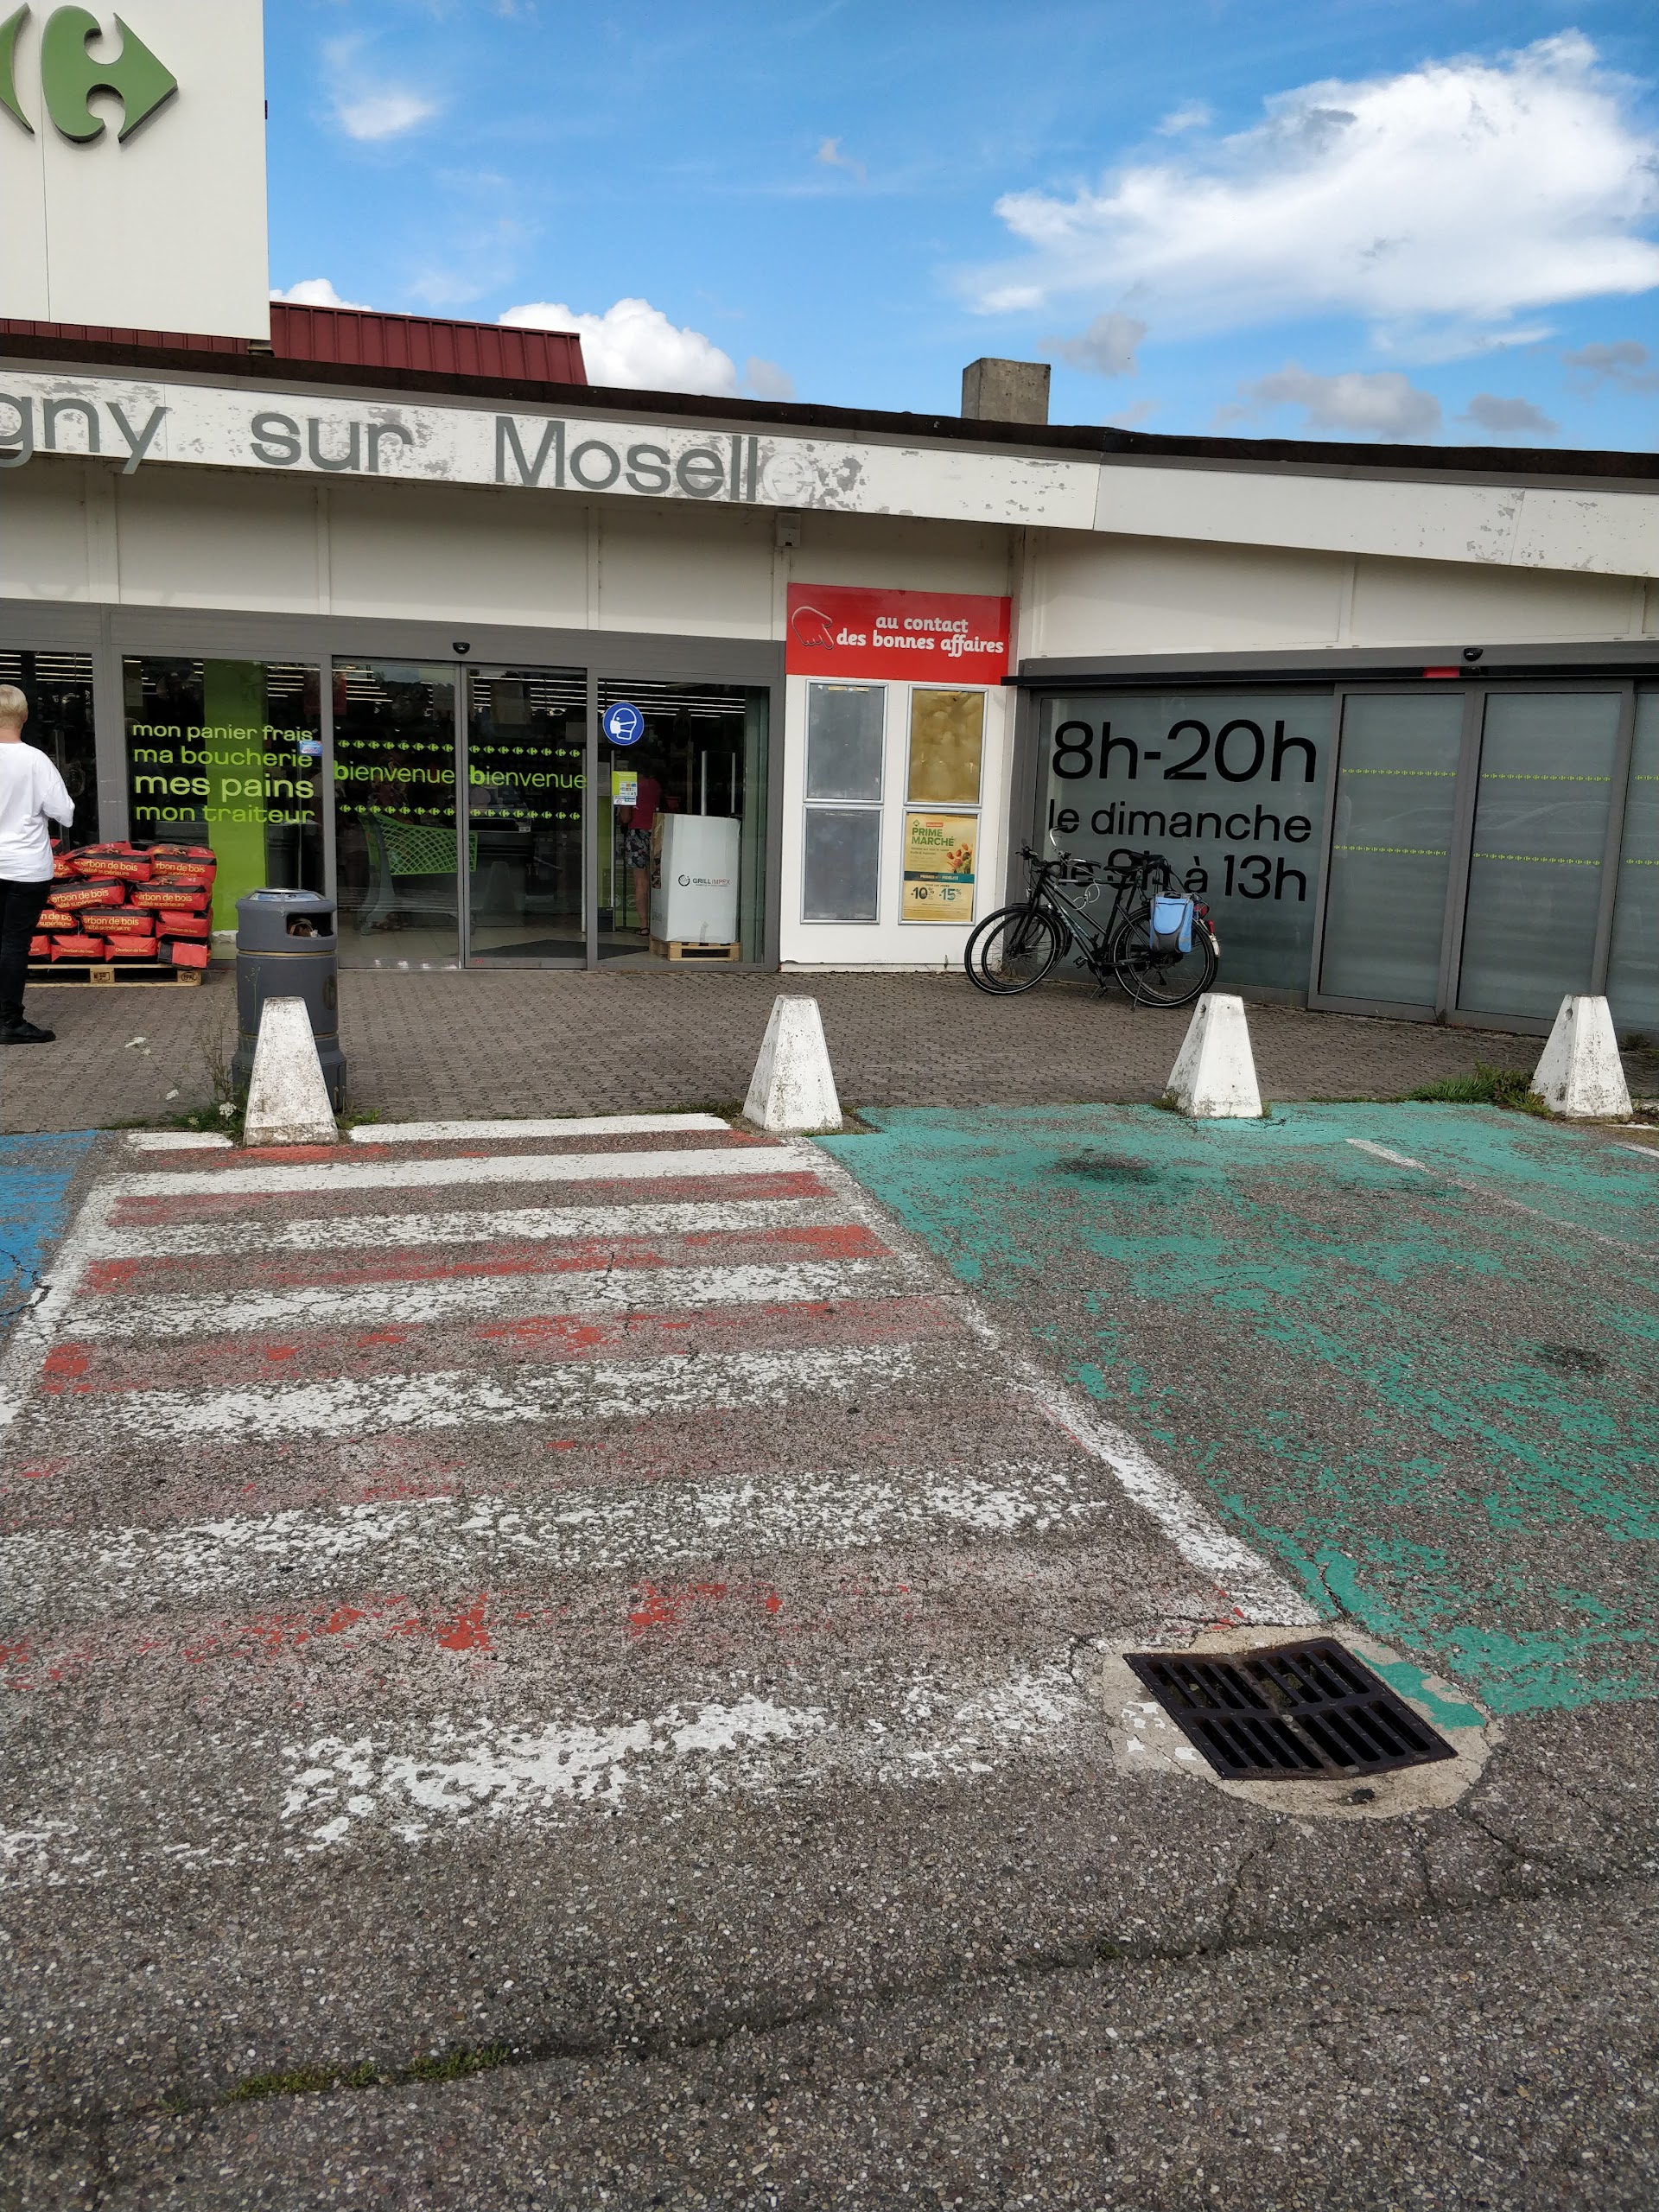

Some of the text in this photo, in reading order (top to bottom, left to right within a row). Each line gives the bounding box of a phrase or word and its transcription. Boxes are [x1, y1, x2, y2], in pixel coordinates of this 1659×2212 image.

[250, 412, 415, 474] sur
[875, 616, 969, 633] au contact
[836, 628, 1004, 658] des bonnes affaires
[132, 724, 314, 743] mon panier frais
[134, 746, 314, 767] ma boucherie
[1052, 719, 1318, 783] 8h-20h
[333, 760, 455, 784] bienvenue
[469, 765, 588, 789] bienvenue
[136, 774, 315, 802] mes pains
[136, 804, 315, 824] mon traiteur
[1048, 798, 1313, 843] le dimanche
[911, 836, 955, 847] MARCHÉ
[912, 827, 943, 837] PRIME
[120, 862, 138, 871] bois
[1184, 855, 1208, 893] à
[1224, 855, 1306, 901] 13h
[91, 889, 109, 898] bois
[175, 893, 193, 902] bois
[48, 912, 60, 920] de
[121, 917, 139, 925] bois
